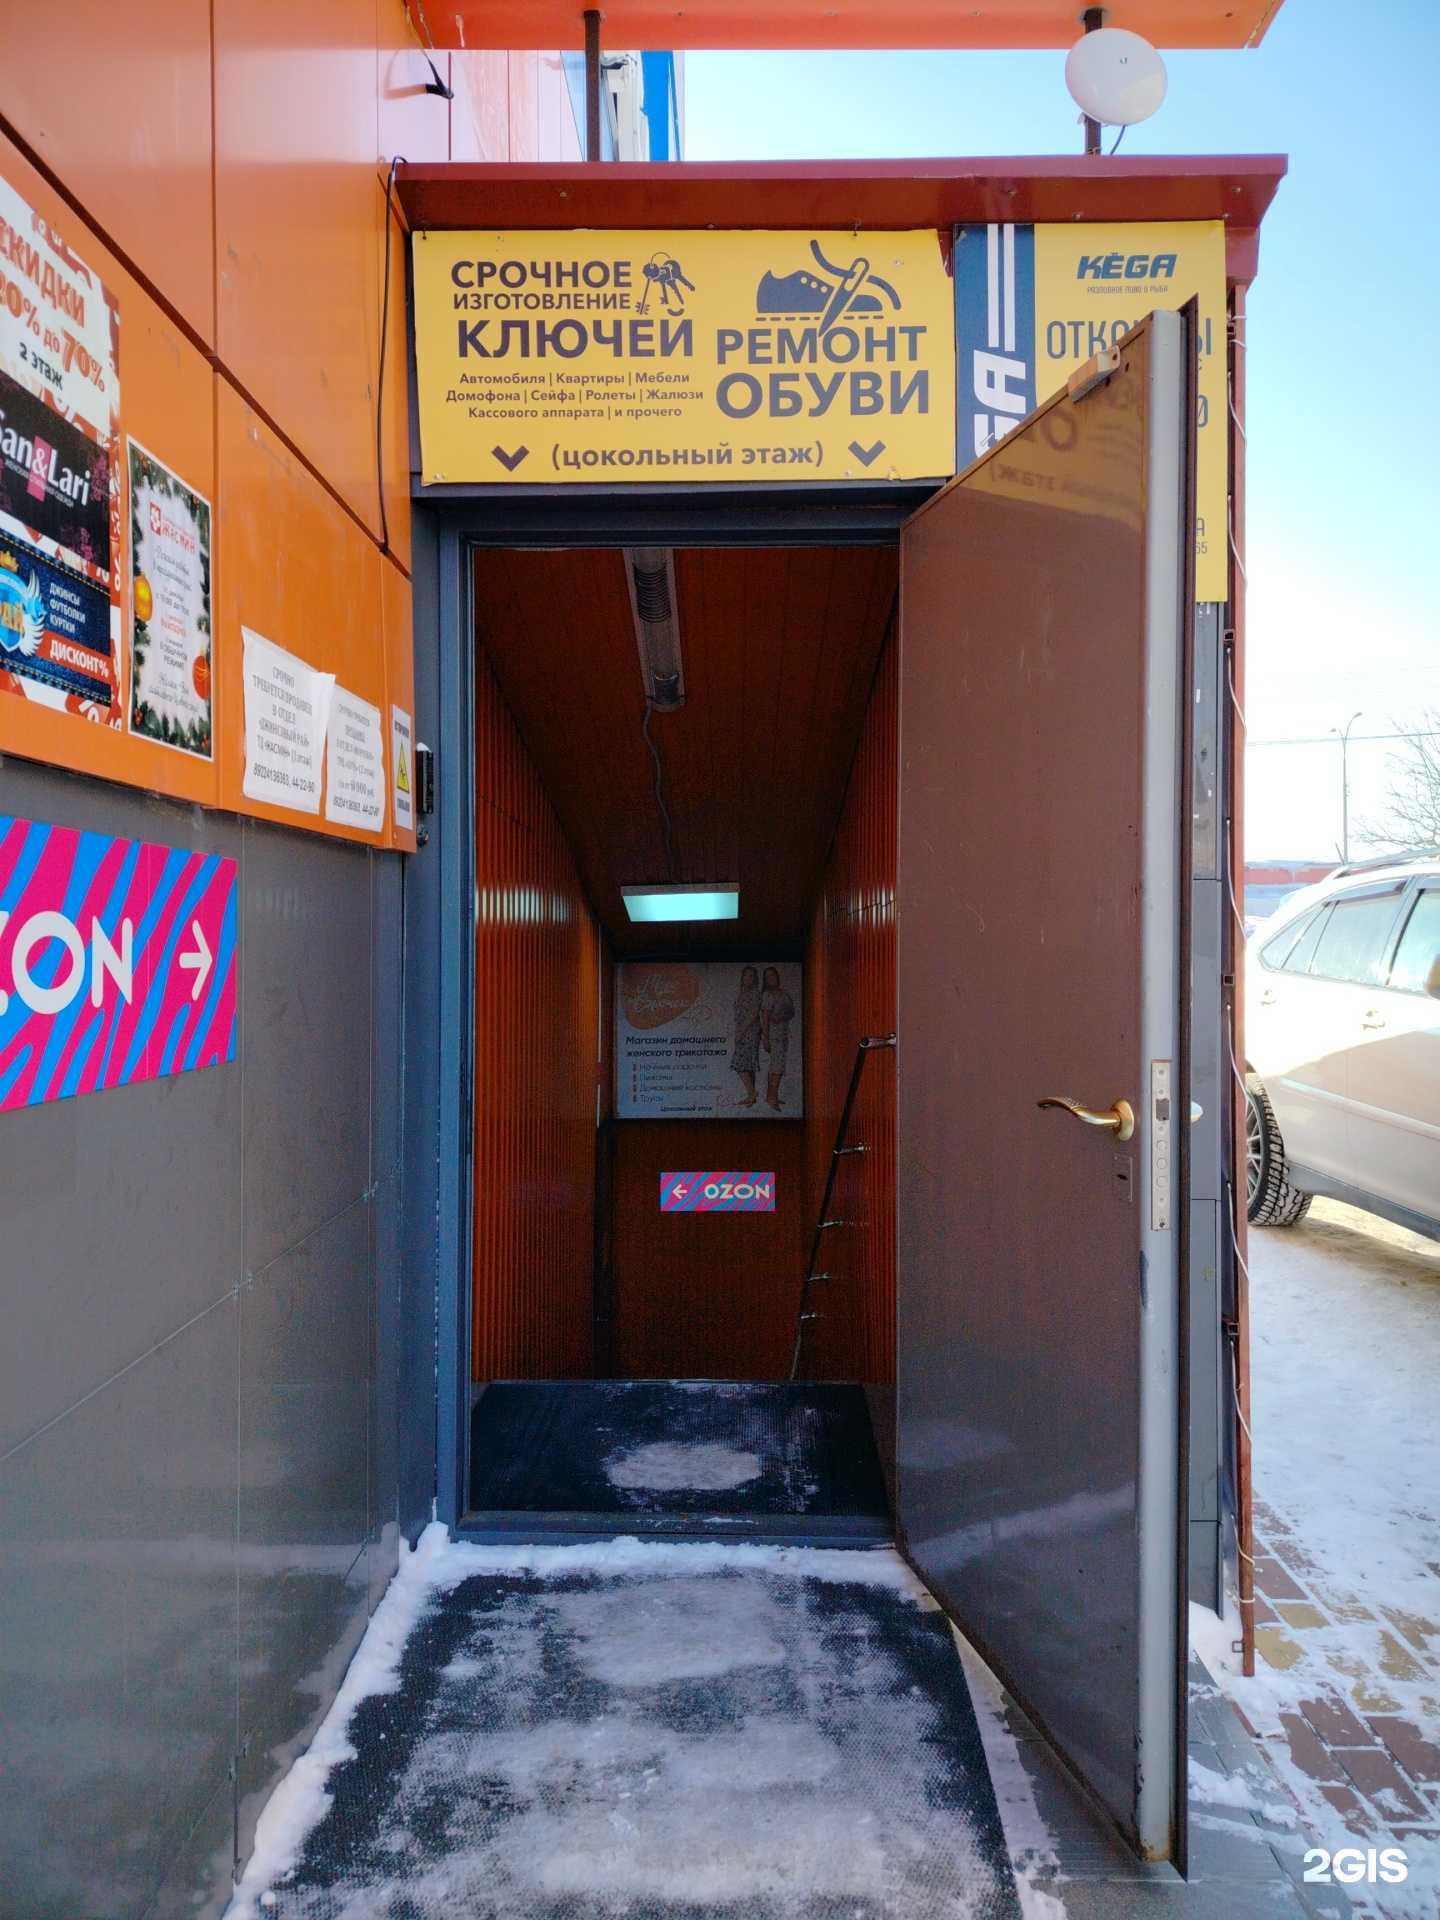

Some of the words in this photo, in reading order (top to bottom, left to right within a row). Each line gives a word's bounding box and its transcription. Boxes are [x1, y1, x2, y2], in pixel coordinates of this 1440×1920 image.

[451, 260, 632, 289] СРОЧНОЕ
[453, 293, 631, 311] ИЗГОТОВЛЕНИЕ
[458, 308, 694, 359] КЛЮЧЕЙ
[717, 326, 927, 365] РЕМОНТ
[19, 341, 27, 361] 2
[30, 352, 63, 391] этаж
[61, 327, 105, 393] 70%
[459, 373, 546, 385] Автомобиля
[556, 373, 625, 386] Квартиры
[635, 371, 690, 384] Мебели
[446, 389, 521, 403] Домофона
[531, 388, 576, 403] Сейфа
[586, 389, 636, 401] Ролеты
[646, 388, 704, 400] Жалюзи
[716, 369, 929, 419] ОБУВИ
[468, 407, 538, 419] Кассового
[542, 408, 604, 420] аппарата
[615, 408, 622, 417] и
[626, 408, 682, 419] прочего
[0, 407, 91, 506] an&Lari
[552, 442, 733, 470] (цокольный
[742, 440, 824, 468] этаж)
[49, 582, 81, 607] ДЖИНСЫ
[49, 598, 86, 624] ФУТБОЛКИ
[49, 612, 76, 634] КУРТКИ
[49, 639, 109, 678] ДИСКОНТ%
[0, 911, 133, 1016] ON
[626, 1035, 668, 1045] Магазин
[626, 1048, 674, 1058] женского
[675, 1048, 727, 1058] трикотажа
[704, 1183, 770, 1200] OZON
